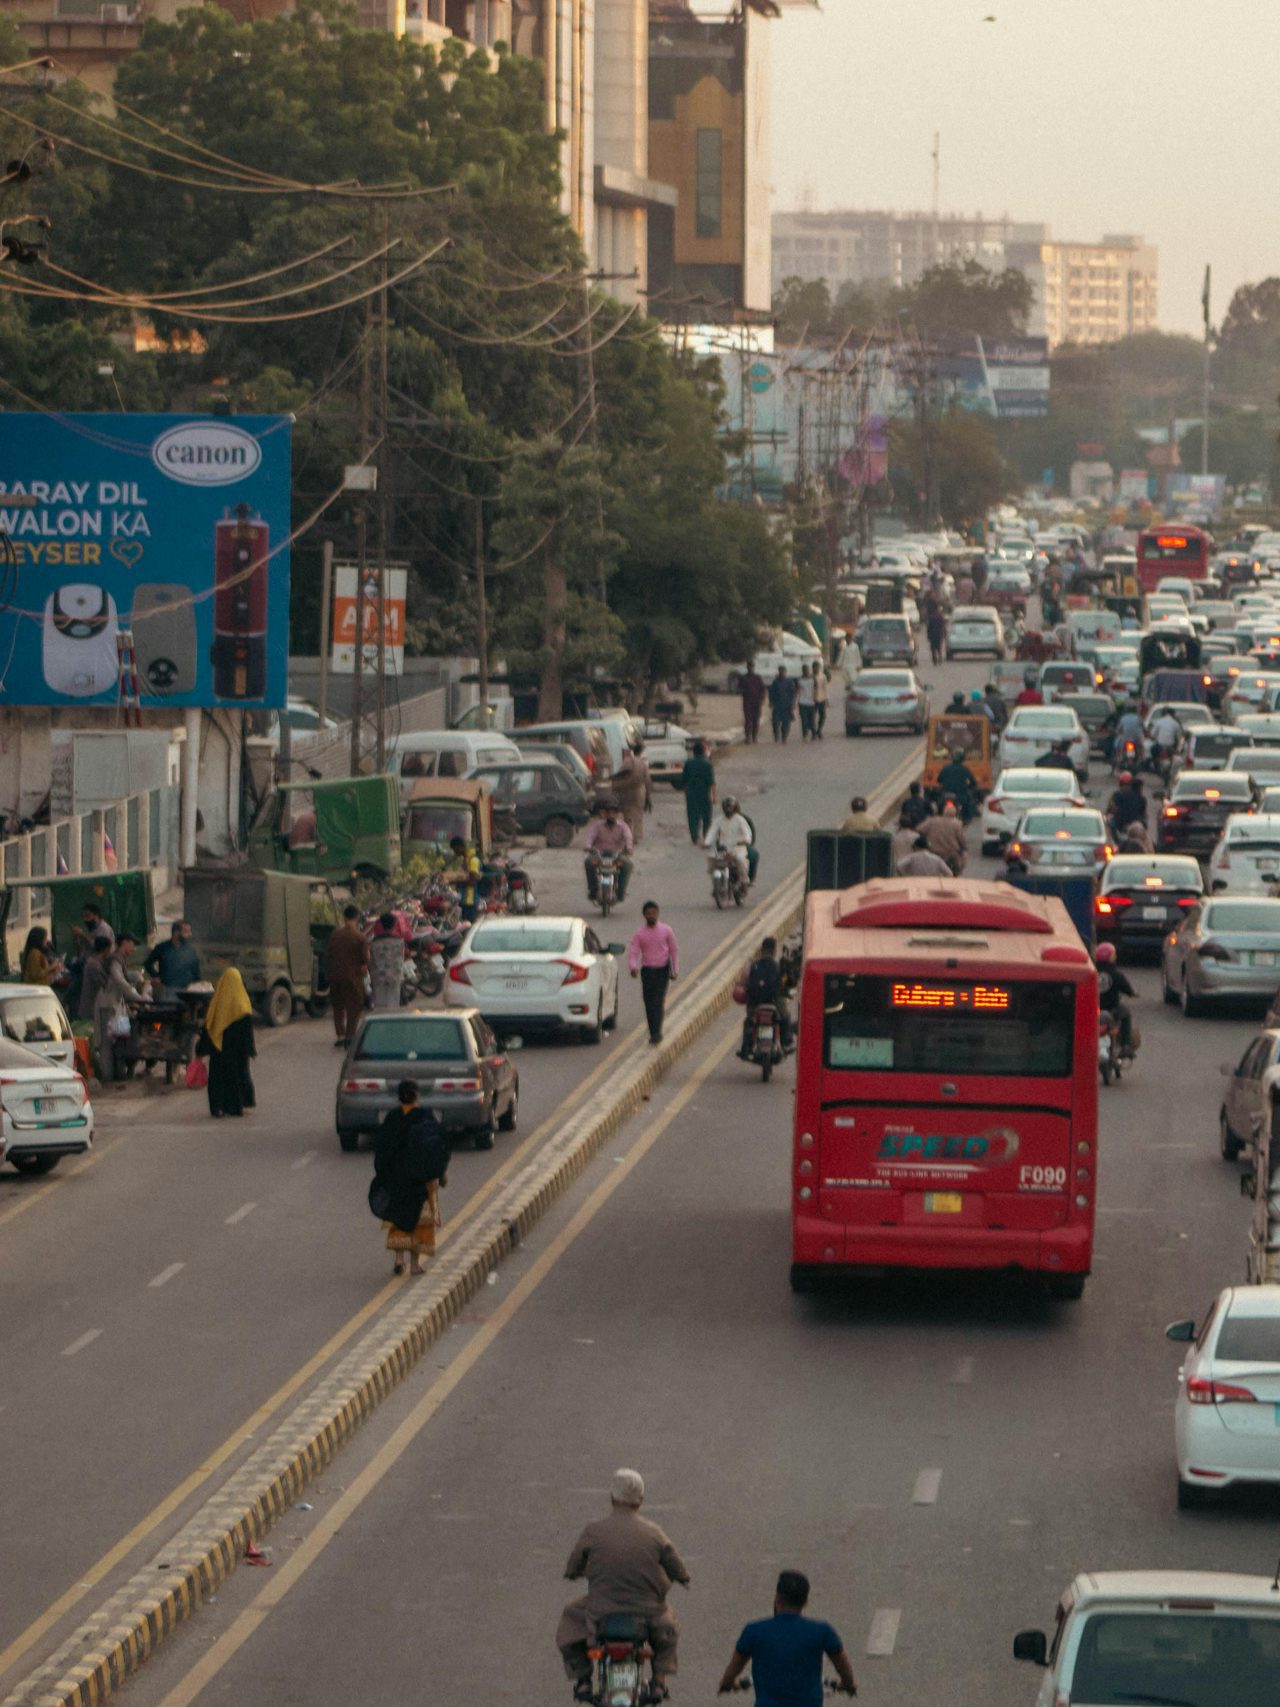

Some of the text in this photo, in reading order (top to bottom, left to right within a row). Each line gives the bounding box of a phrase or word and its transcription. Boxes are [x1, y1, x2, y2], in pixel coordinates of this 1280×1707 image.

[99, 481, 148, 505] DIL
[112, 510, 151, 537] KA
[1020, 1165, 1066, 1185] F090
